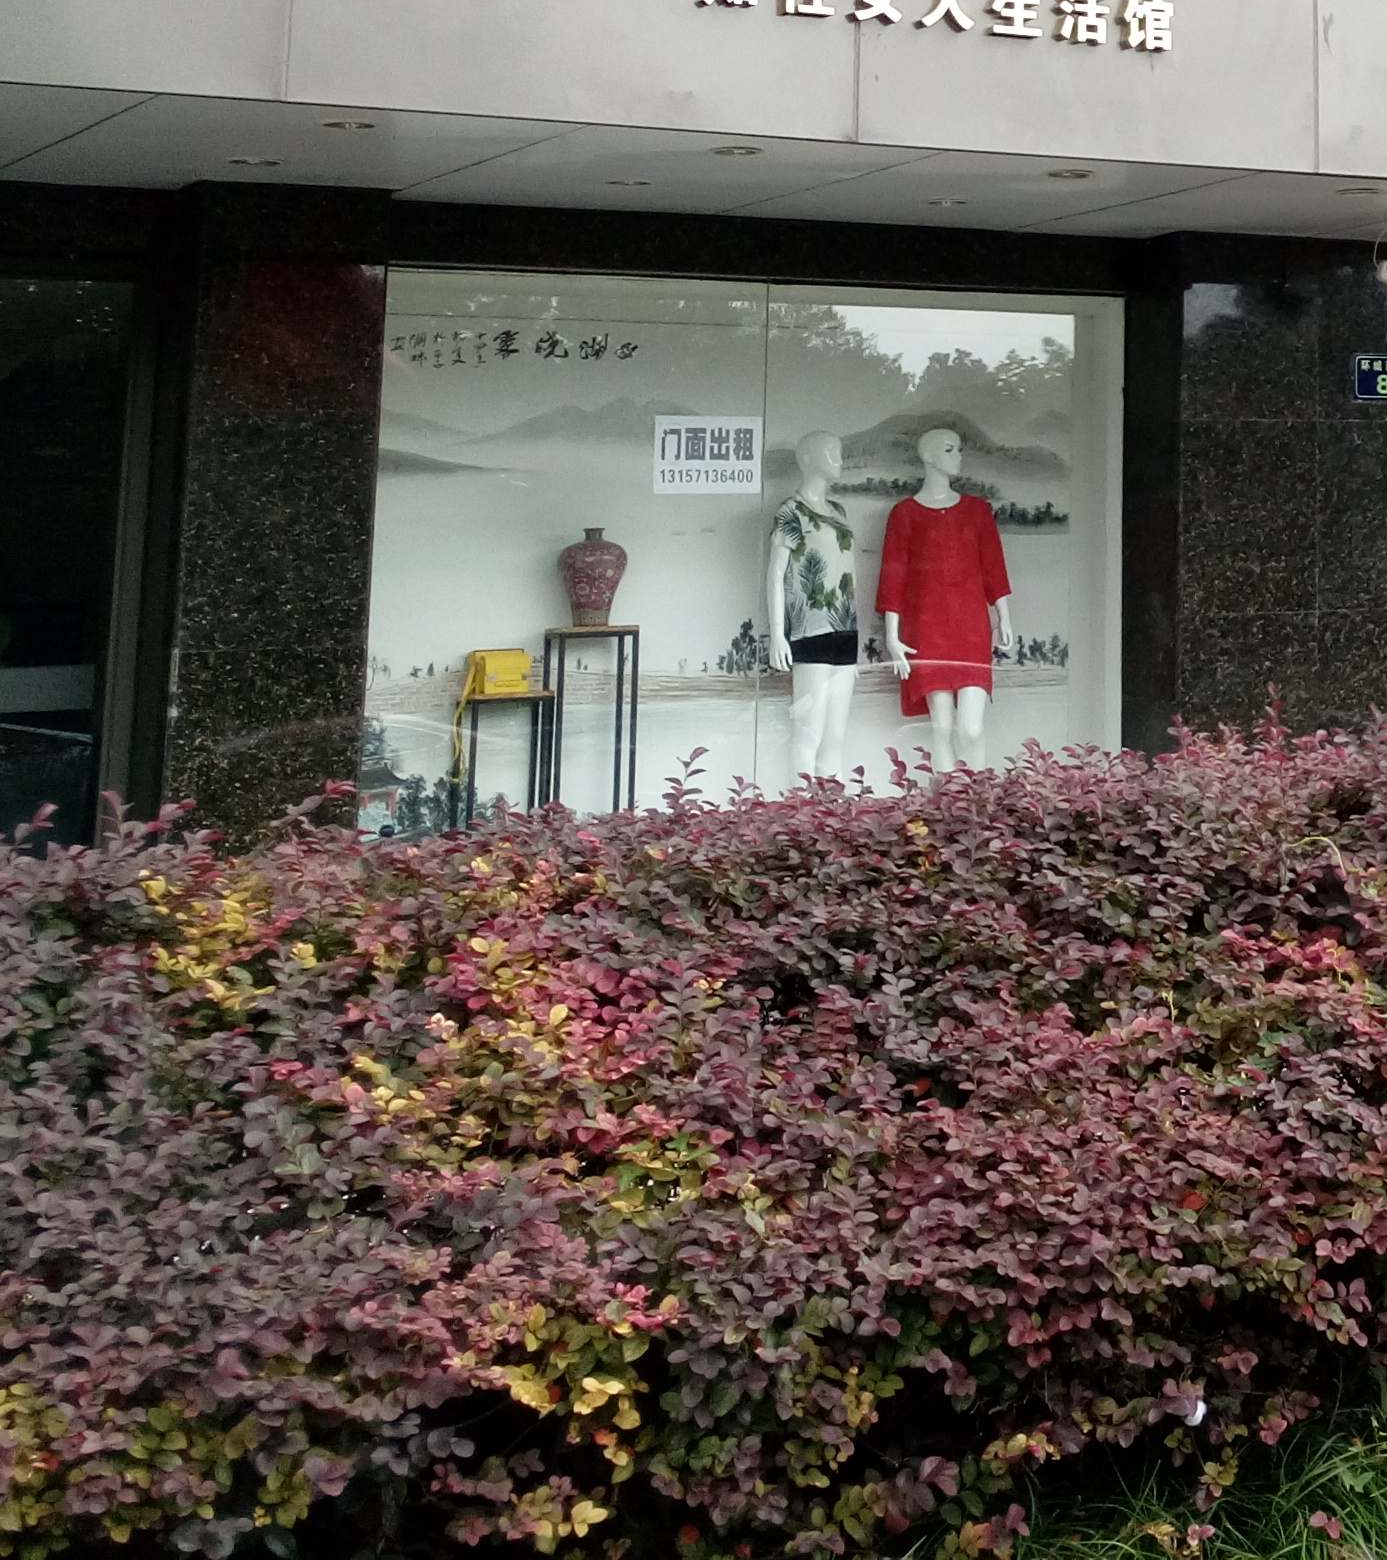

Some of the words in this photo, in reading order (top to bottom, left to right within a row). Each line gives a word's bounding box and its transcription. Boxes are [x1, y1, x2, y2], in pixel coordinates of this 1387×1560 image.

[661, 427, 754, 461] 门面出租
[660, 469, 753, 483] 13157136400
